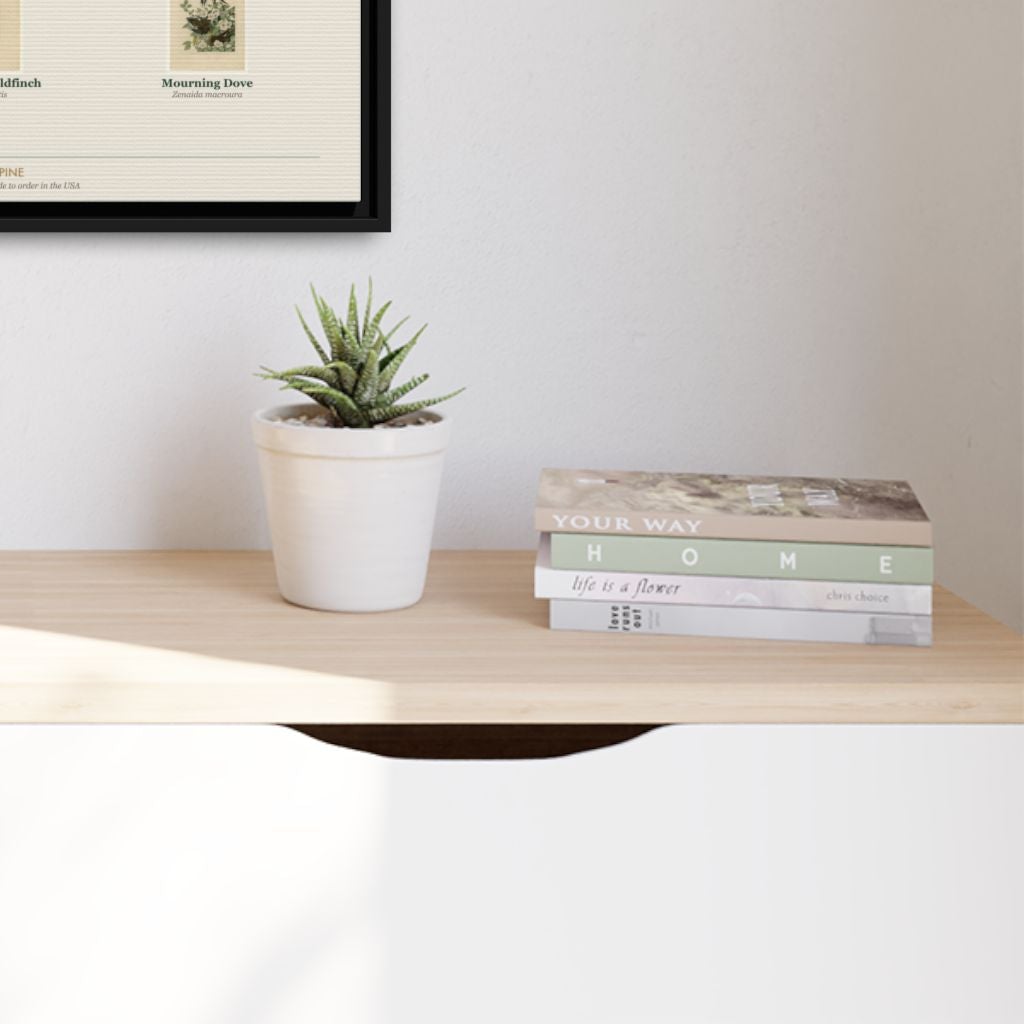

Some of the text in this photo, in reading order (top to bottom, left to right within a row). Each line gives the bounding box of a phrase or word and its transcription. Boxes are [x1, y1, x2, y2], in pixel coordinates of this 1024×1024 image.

[162, 78, 253, 90] Mourning Dove
[0, 168, 24, 178] PINE
[18, 181, 39, 190] order
[49, 181, 62, 190] the
[64, 181, 80, 190] USA
[552, 514, 702, 533] YOUR WAY
[587, 543, 893, 574] HOME
[572, 575, 682, 598] life is a flower
[608, 605, 619, 630] love
[622, 605, 631, 631] runs
[632, 609, 642, 628] out
